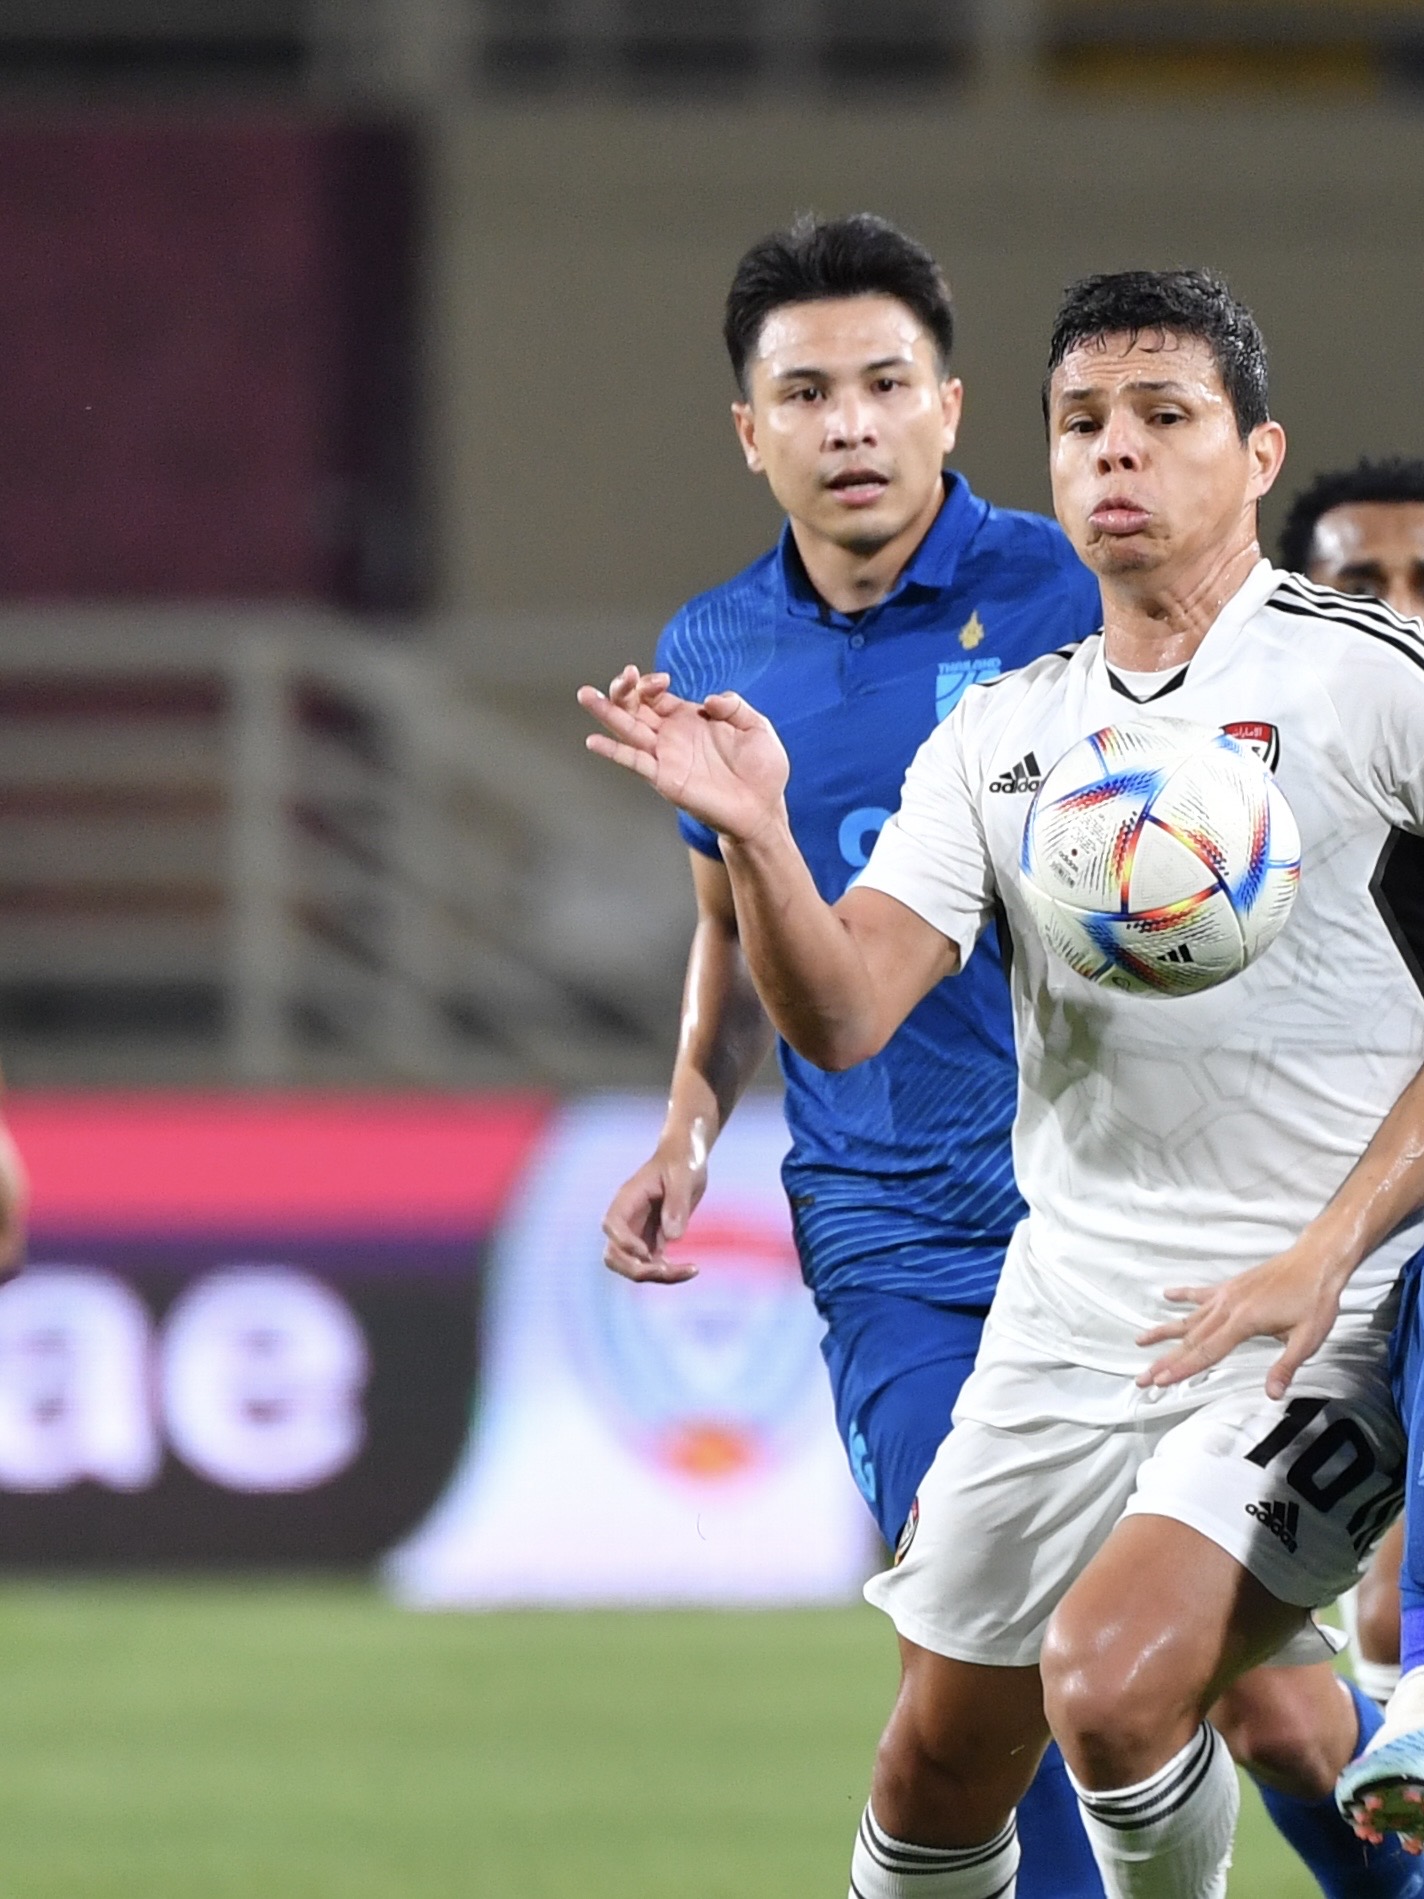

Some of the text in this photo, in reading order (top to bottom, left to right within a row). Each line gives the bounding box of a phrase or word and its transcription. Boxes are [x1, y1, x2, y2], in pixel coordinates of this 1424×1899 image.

[989, 777, 1041, 794] adida
[1244, 1397, 1377, 1514] 10
[1245, 1502, 1298, 1554] adidas
